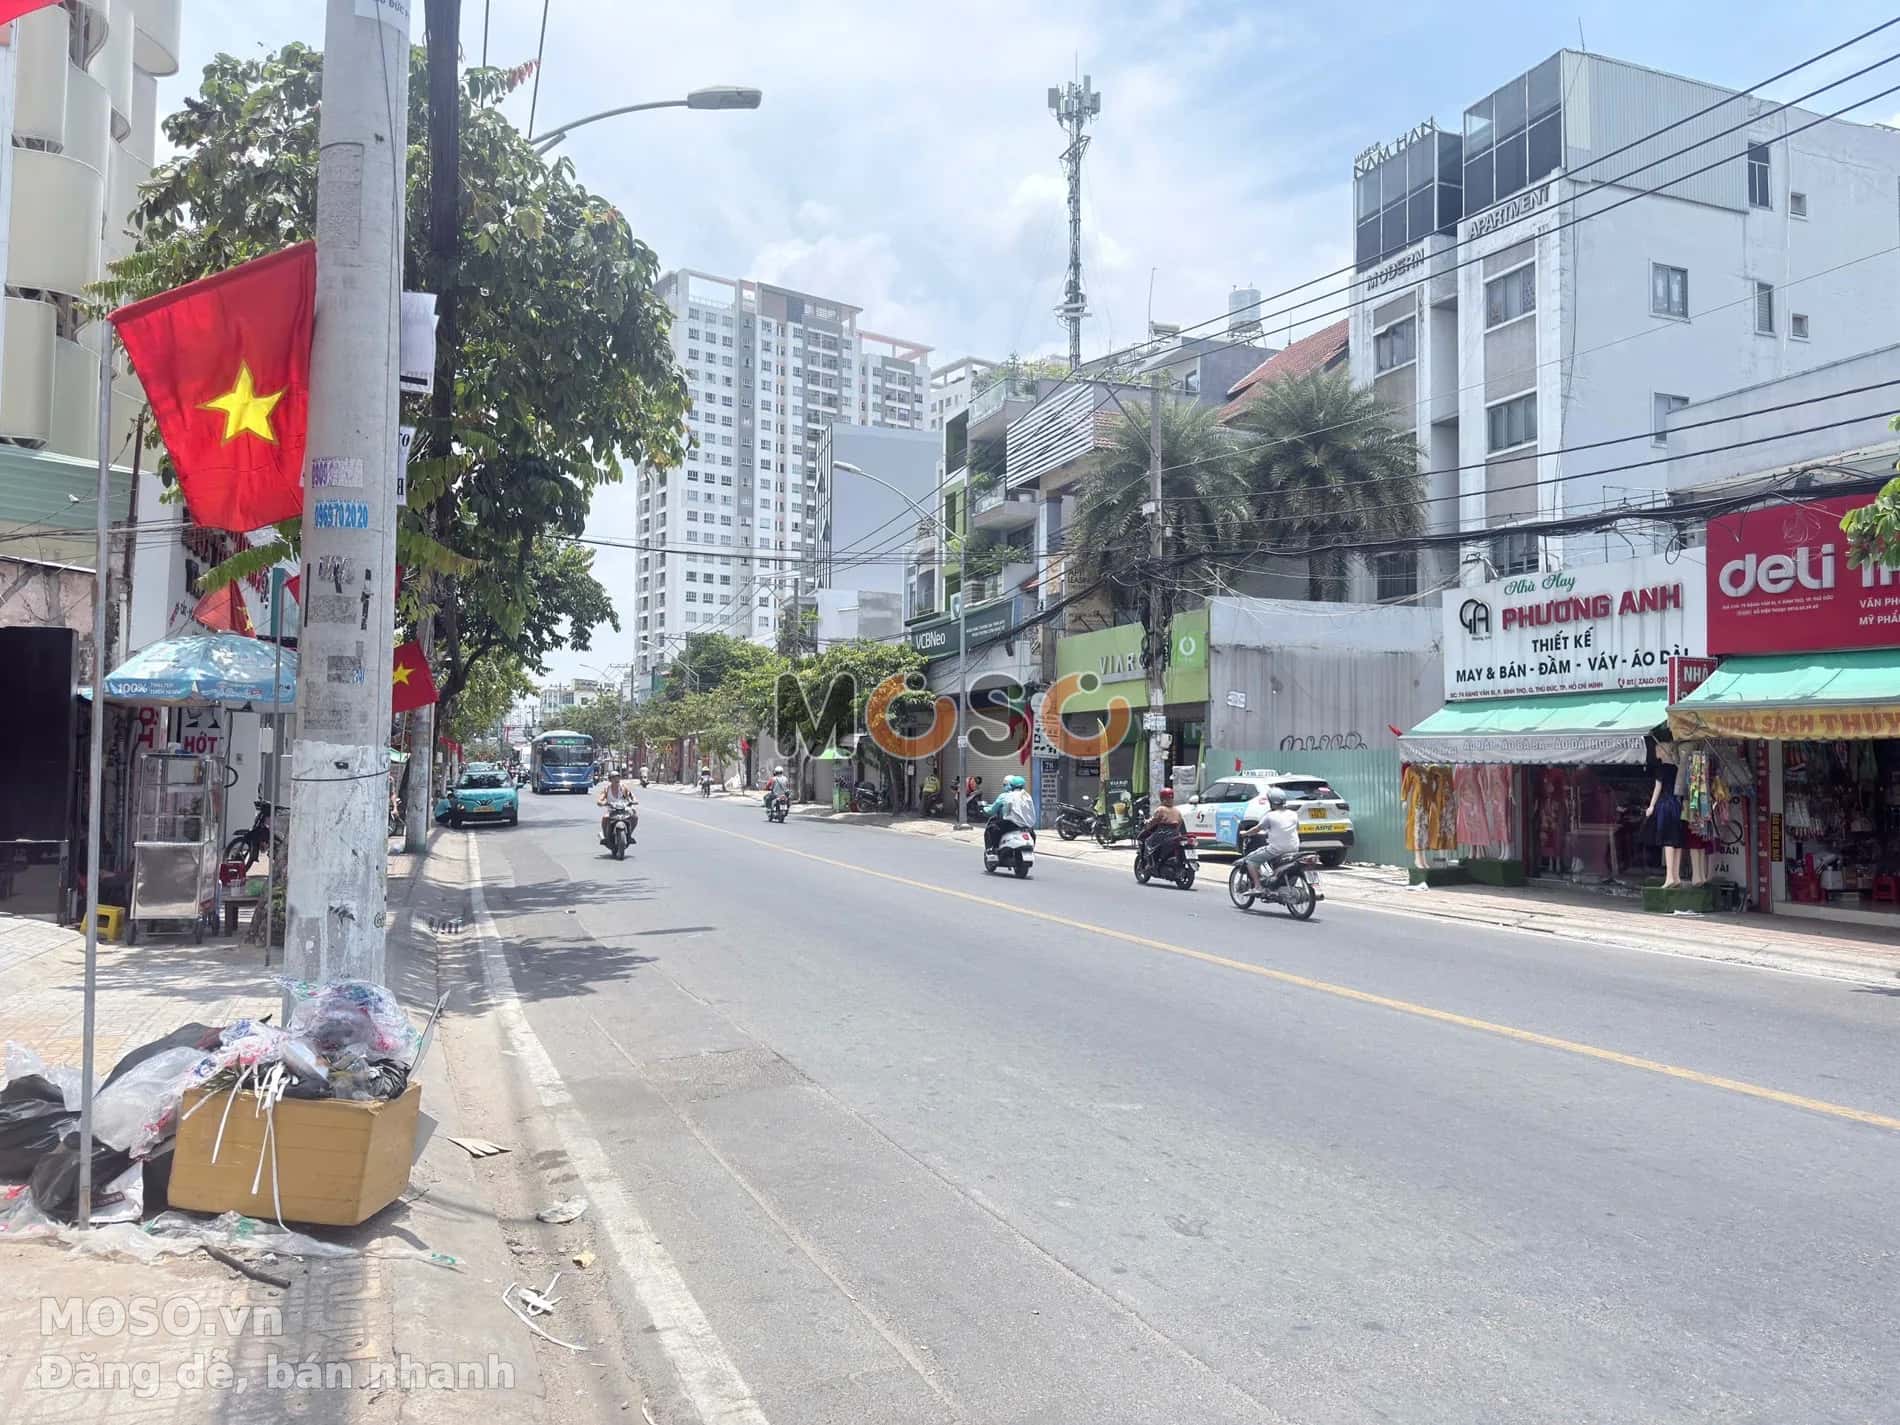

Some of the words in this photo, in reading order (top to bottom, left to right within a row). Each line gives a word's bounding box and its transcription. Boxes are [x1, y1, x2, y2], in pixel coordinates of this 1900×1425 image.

[1469, 185, 1550, 239] APARTMENT
[1367, 248, 1425, 291] MODERN
[1504, 580, 1535, 595] Nhà
[1719, 544, 1835, 597] deli
[1502, 595, 1611, 631] PHƯƠNG
[1618, 583, 1682, 615] ANH
[1860, 597, 1882, 608] VĂN
[1885, 597, 1900, 607] PH
[916, 632, 945, 650] VCBNeo
[1532, 630, 1569, 653] THIẾT
[1574, 627, 1594, 649] KẾ
[1456, 667, 1482, 683] MAY
[1486, 667, 1495, 680] &
[1500, 661, 1526, 679] BÁN
[1538, 655, 1571, 675] ĐẦM
[1588, 651, 1618, 671] VÁY
[1631, 649, 1655, 668] ÁO
